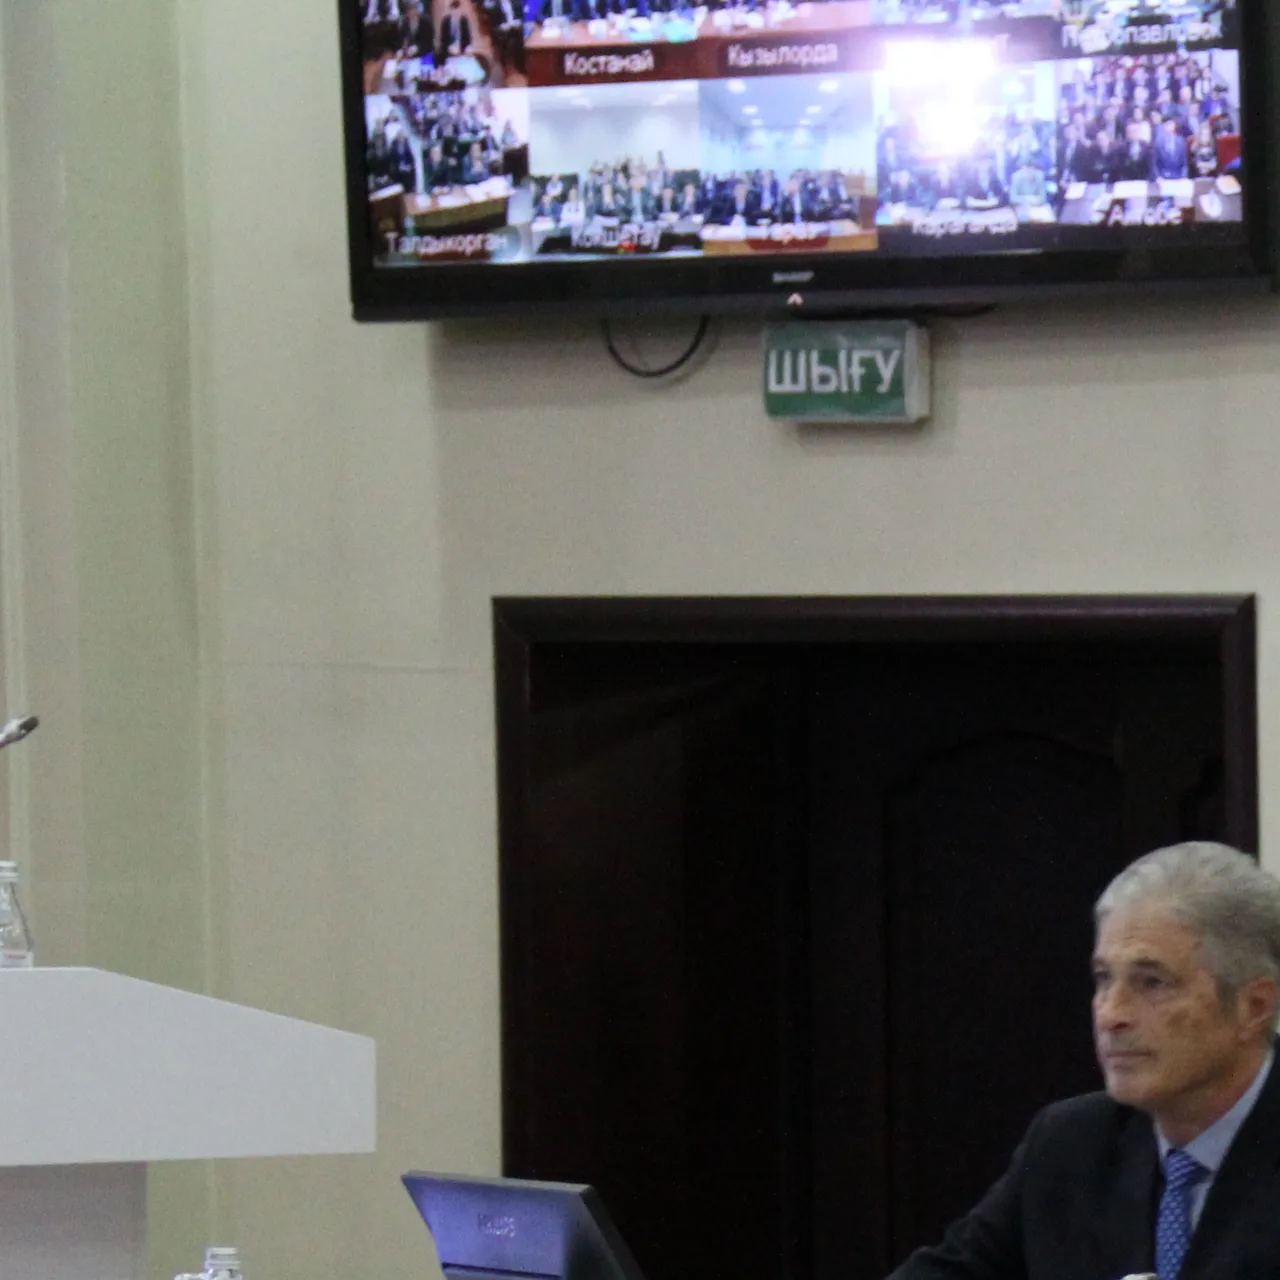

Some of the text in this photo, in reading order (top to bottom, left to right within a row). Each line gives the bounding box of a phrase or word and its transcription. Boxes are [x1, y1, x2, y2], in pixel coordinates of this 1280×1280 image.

[564, 49, 655, 75] Костанай
[727, 41, 838, 68] Кызылорда
[767, 349, 901, 394] ШЫҒУ
